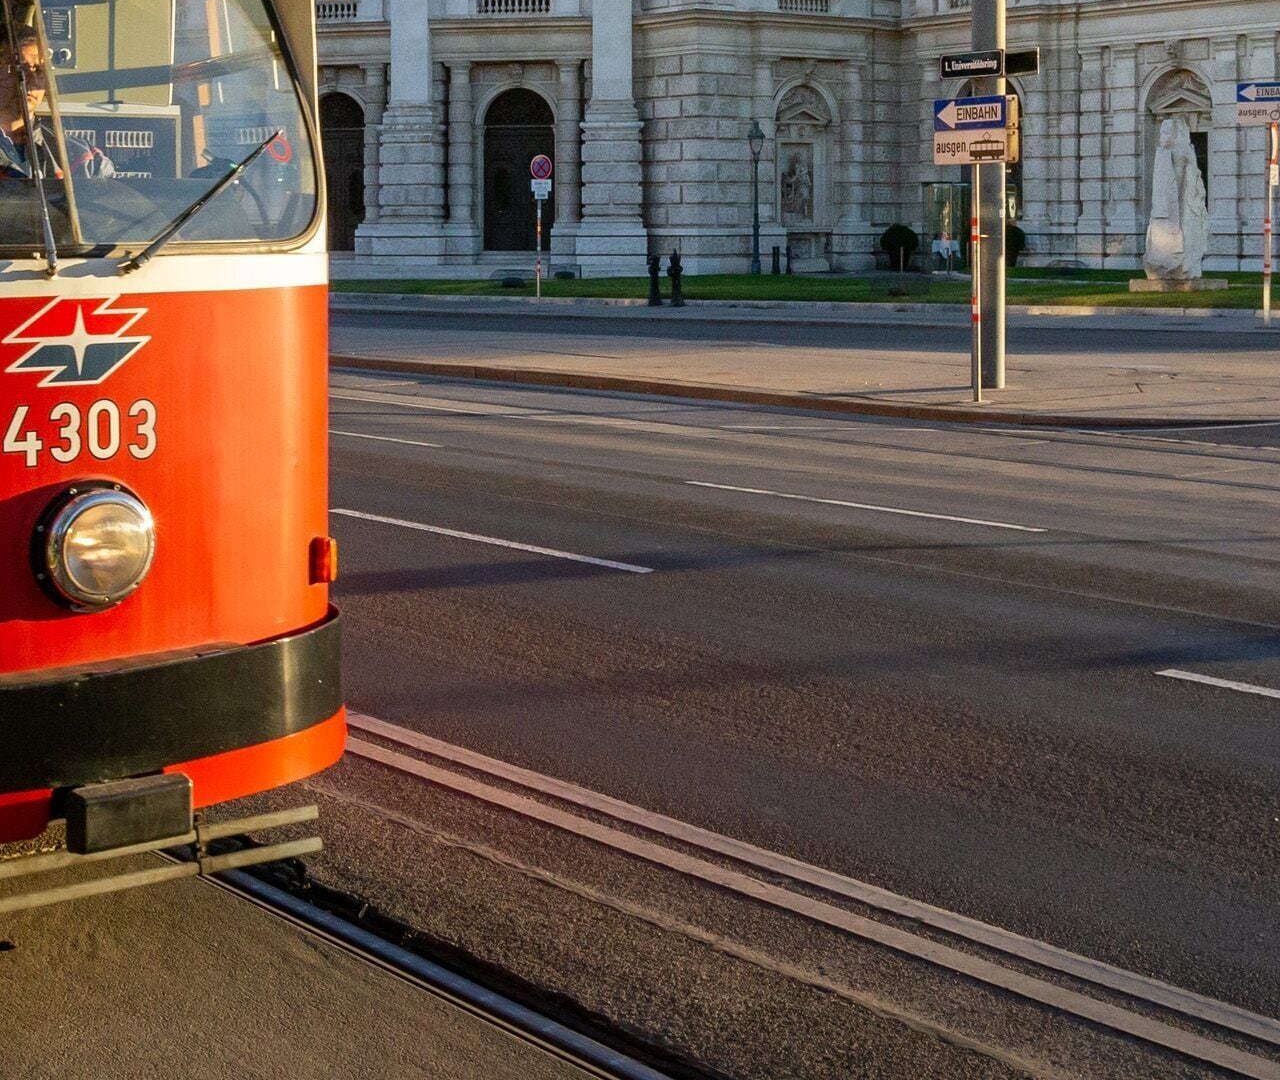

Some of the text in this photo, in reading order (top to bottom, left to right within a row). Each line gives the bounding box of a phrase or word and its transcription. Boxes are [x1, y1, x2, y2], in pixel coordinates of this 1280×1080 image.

[956, 106, 998, 121] EINBAHN
[936, 141, 969, 157] ausgen.
[2, 398, 158, 468] 4303
